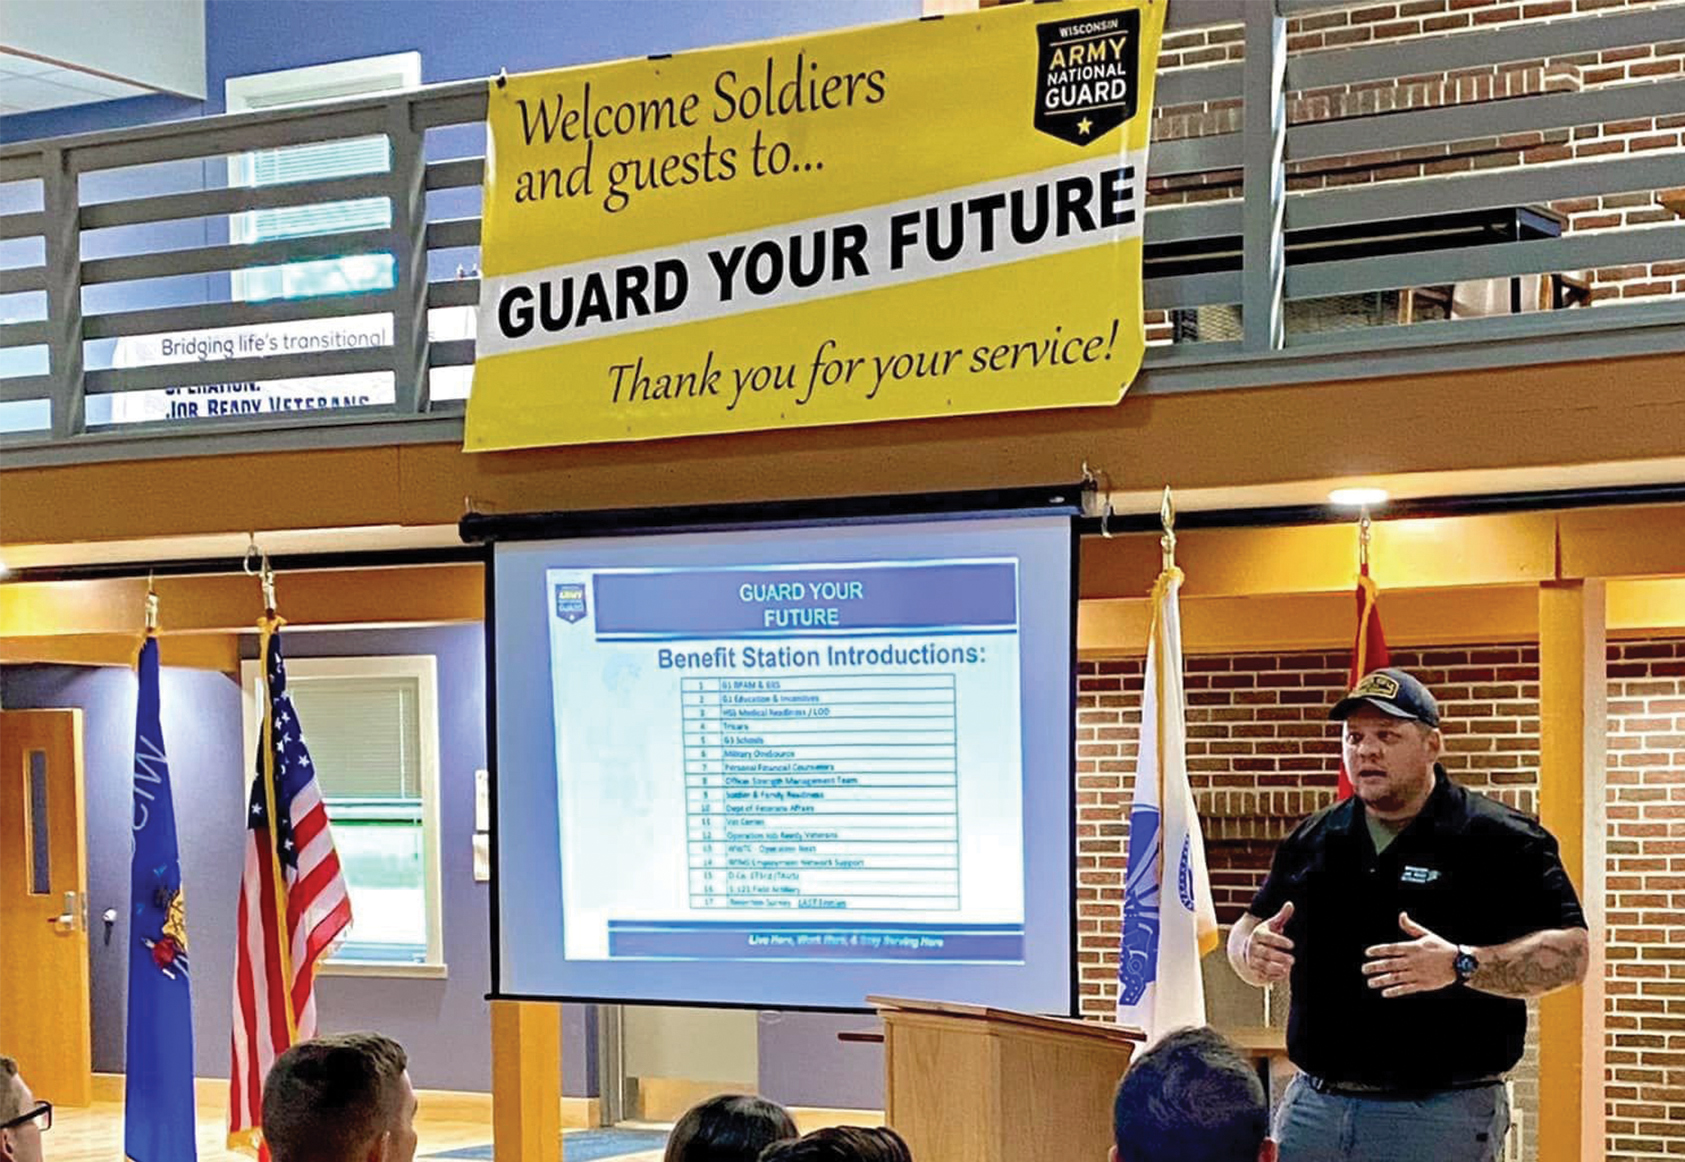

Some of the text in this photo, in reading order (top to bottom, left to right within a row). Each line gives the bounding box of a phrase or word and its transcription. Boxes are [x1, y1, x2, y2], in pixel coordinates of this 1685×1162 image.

[1059, 18, 1118, 38] WISCONSIN
[1049, 37, 1126, 71] ARMY
[1047, 62, 1126, 87] NATIONAL
[517, 54, 886, 146] Welcome Soldiers
[1045, 78, 1127, 108] GUARD
[515, 129, 823, 213] and guests to...
[498, 166, 1136, 339] GUARD YOUR FUTURE
[162, 328, 386, 362] Bridging life's transitional
[608, 319, 1119, 410] Thank you for your service!
[207, 399, 261, 416] READY
[740, 582, 863, 601] GUARD YOUR
[764, 608, 839, 627] FUTURE
[658, 643, 985, 669] Benefit Station Introductions:
[734, 695, 770, 703] Education
[738, 708, 767, 716] Medical
[736, 736, 764, 744] Schools
[724, 750, 751, 759] Military
[785, 776, 836, 786] Management
[837, 776, 858, 784] Team
[756, 804, 788, 812] Veterans
[790, 804, 814, 812] Affairs
[727, 832, 763, 841] Operation
[834, 859, 864, 868] Support
[749, 935, 769, 945] Live
[797, 935, 820, 945] Work
[884, 936, 919, 948] Serving
[920, 937, 944, 947] Here
